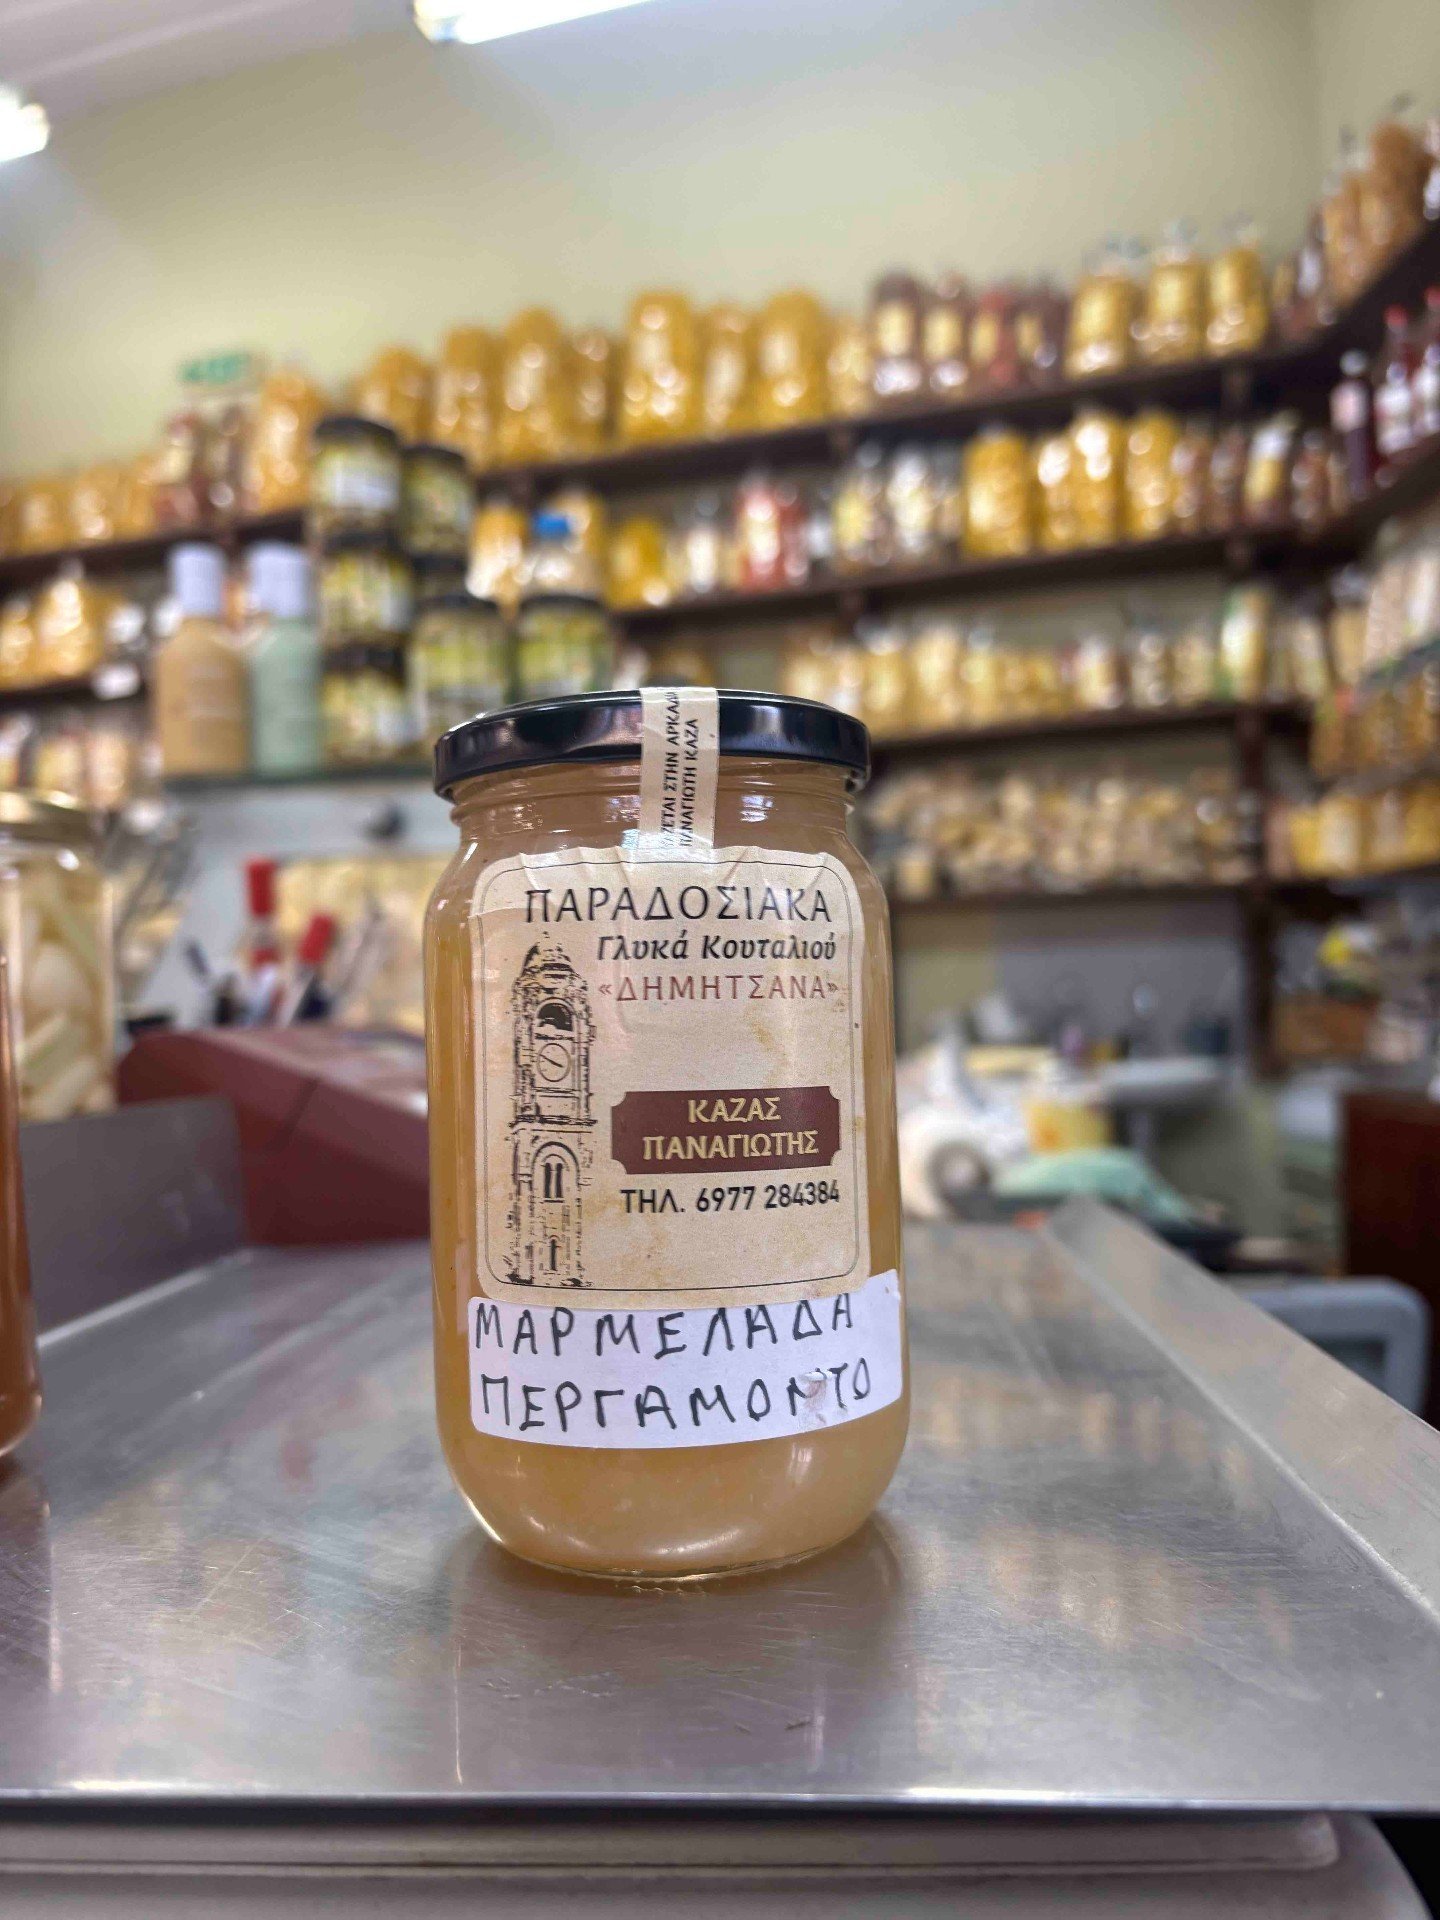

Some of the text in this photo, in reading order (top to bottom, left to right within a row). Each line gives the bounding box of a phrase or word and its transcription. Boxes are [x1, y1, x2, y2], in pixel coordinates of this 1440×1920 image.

[684, 719, 699, 761] ΚΑΖΑ
[663, 752, 680, 793] ΣΤΗΝ
[525, 885, 832, 923] ΠΑΡΑΔΟΣΙΑΚΑ
[597, 929, 836, 961] Γλυκά Κουταλιού
[599, 975, 839, 1002] «ΔΗΜΗΤΣΑΝΑ»
[688, 1096, 781, 1124] ΚΑΖΑΣ
[642, 1130, 819, 1161] ΠΑΝΑΓΙΩΤΗΣ
[621, 1179, 840, 1214] ΤΗΛ. 6977 284384
[475, 1292, 854, 1360] ΜΑΡΜΕΛΑΔΑ
